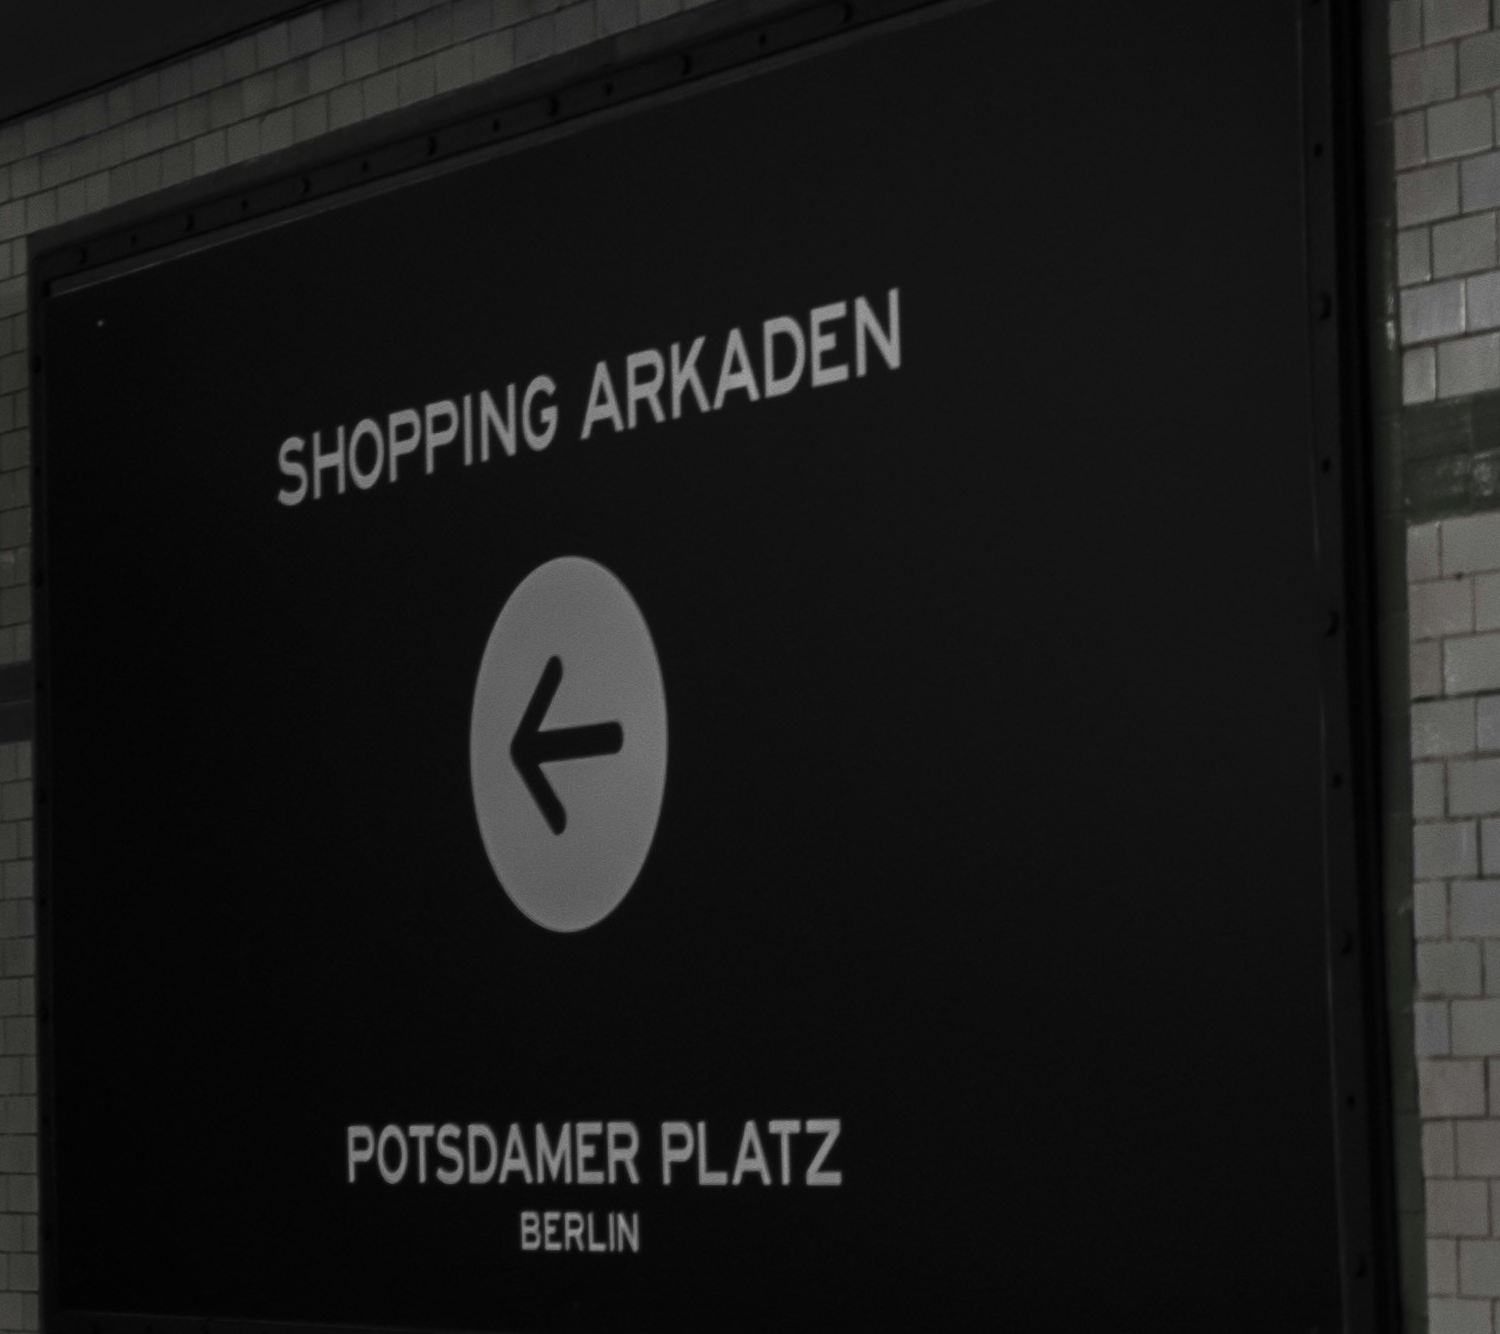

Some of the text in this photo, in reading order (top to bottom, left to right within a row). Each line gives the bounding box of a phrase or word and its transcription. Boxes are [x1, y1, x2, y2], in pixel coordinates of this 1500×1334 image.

[277, 287, 903, 507] SHOPPING ARKADEN
[347, 1118, 844, 1187] POTSDAMER PLATZ
[520, 1210, 640, 1253] BERLIN
